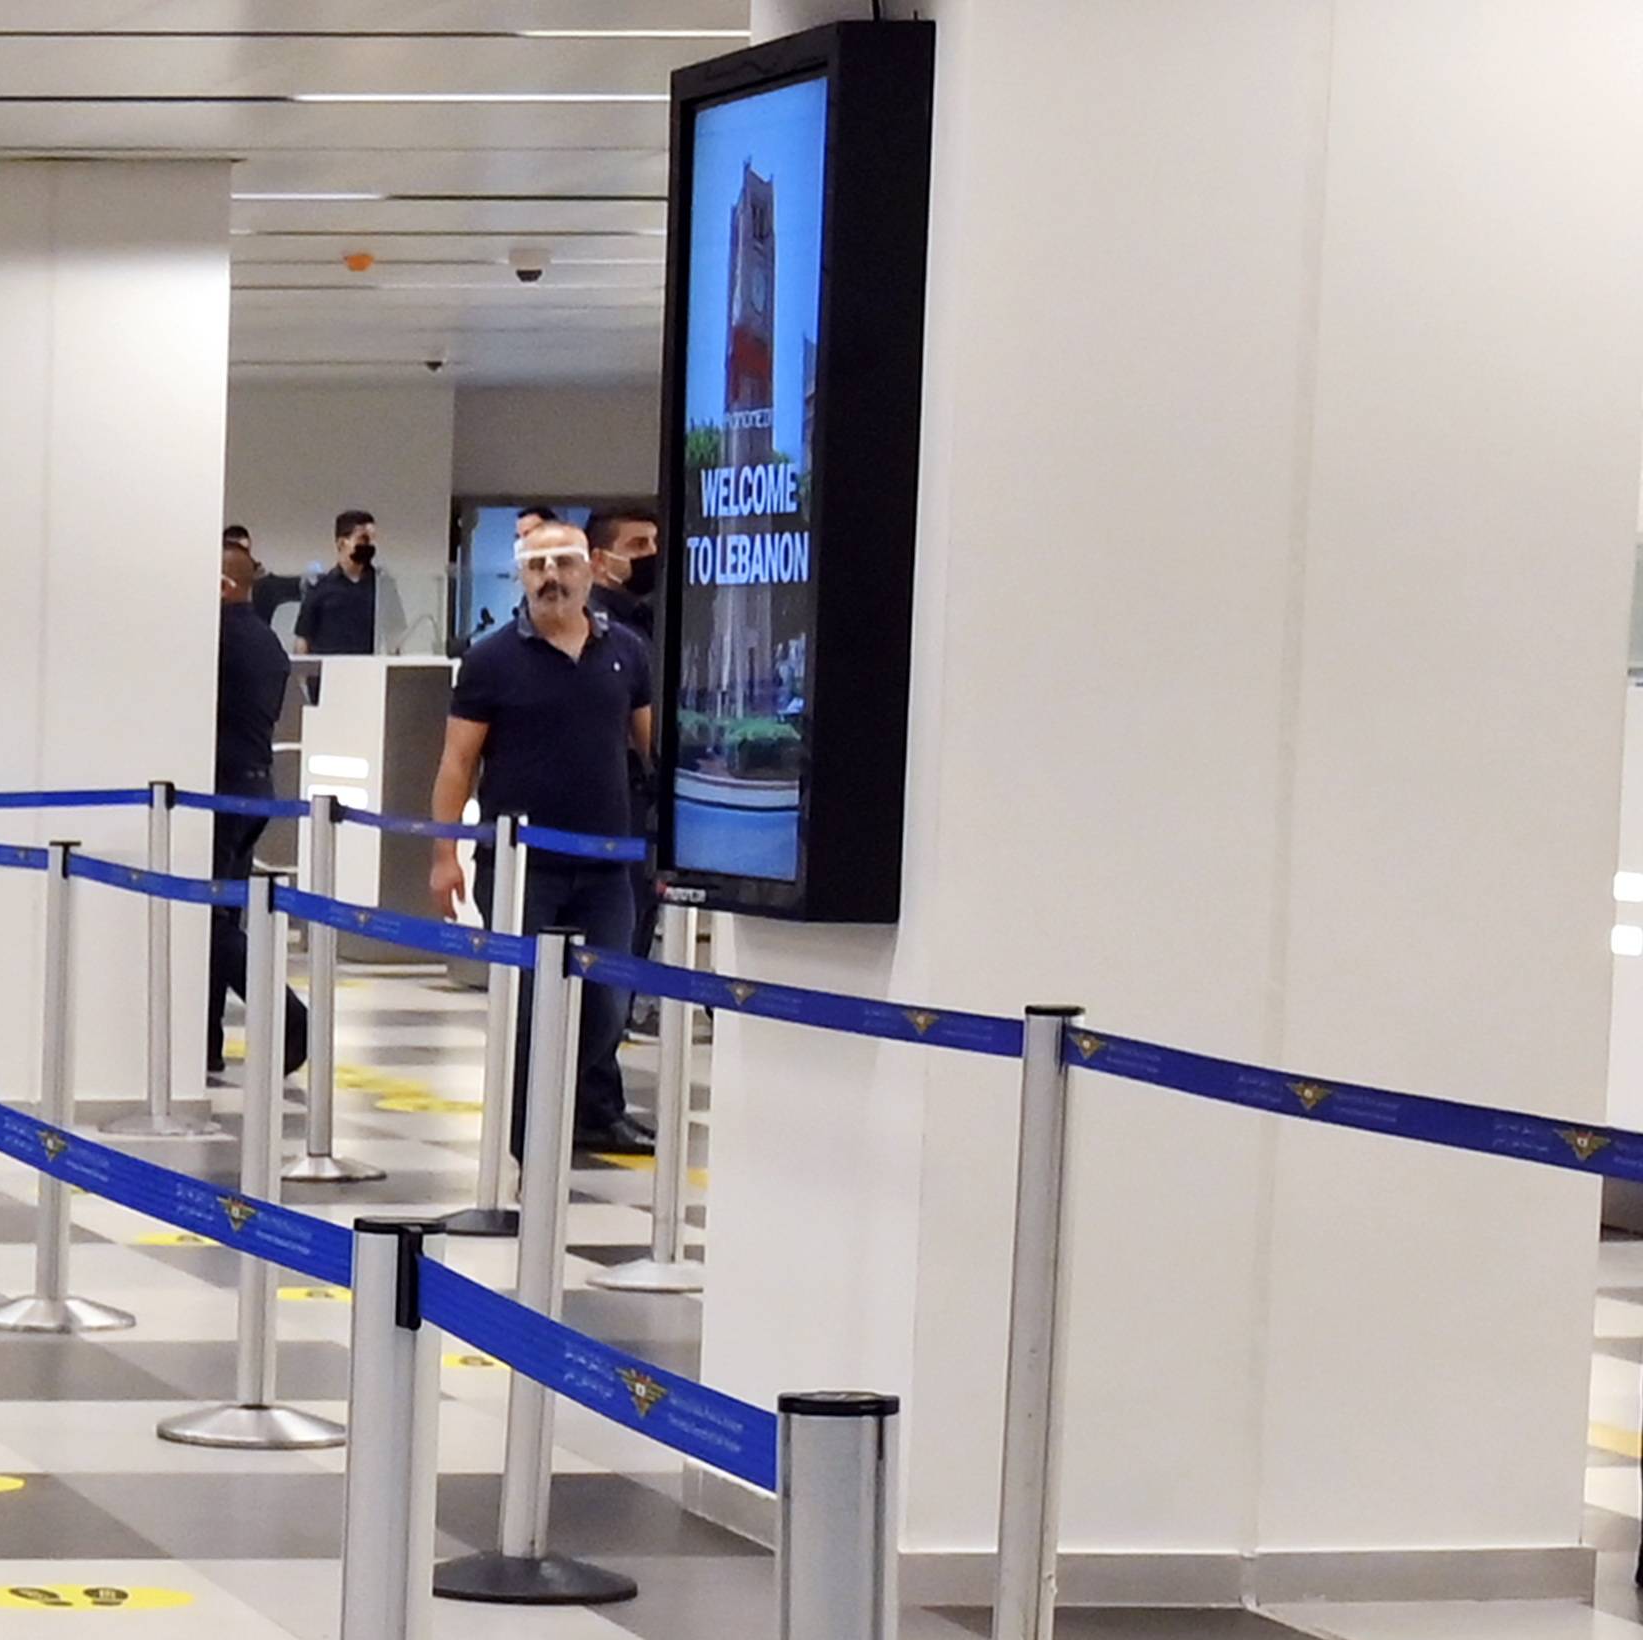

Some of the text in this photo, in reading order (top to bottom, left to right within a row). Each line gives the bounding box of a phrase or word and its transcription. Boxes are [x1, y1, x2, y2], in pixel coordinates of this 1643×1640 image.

[700, 464, 799, 518] WELCOME
[687, 531, 811, 586] TO LEBANON
